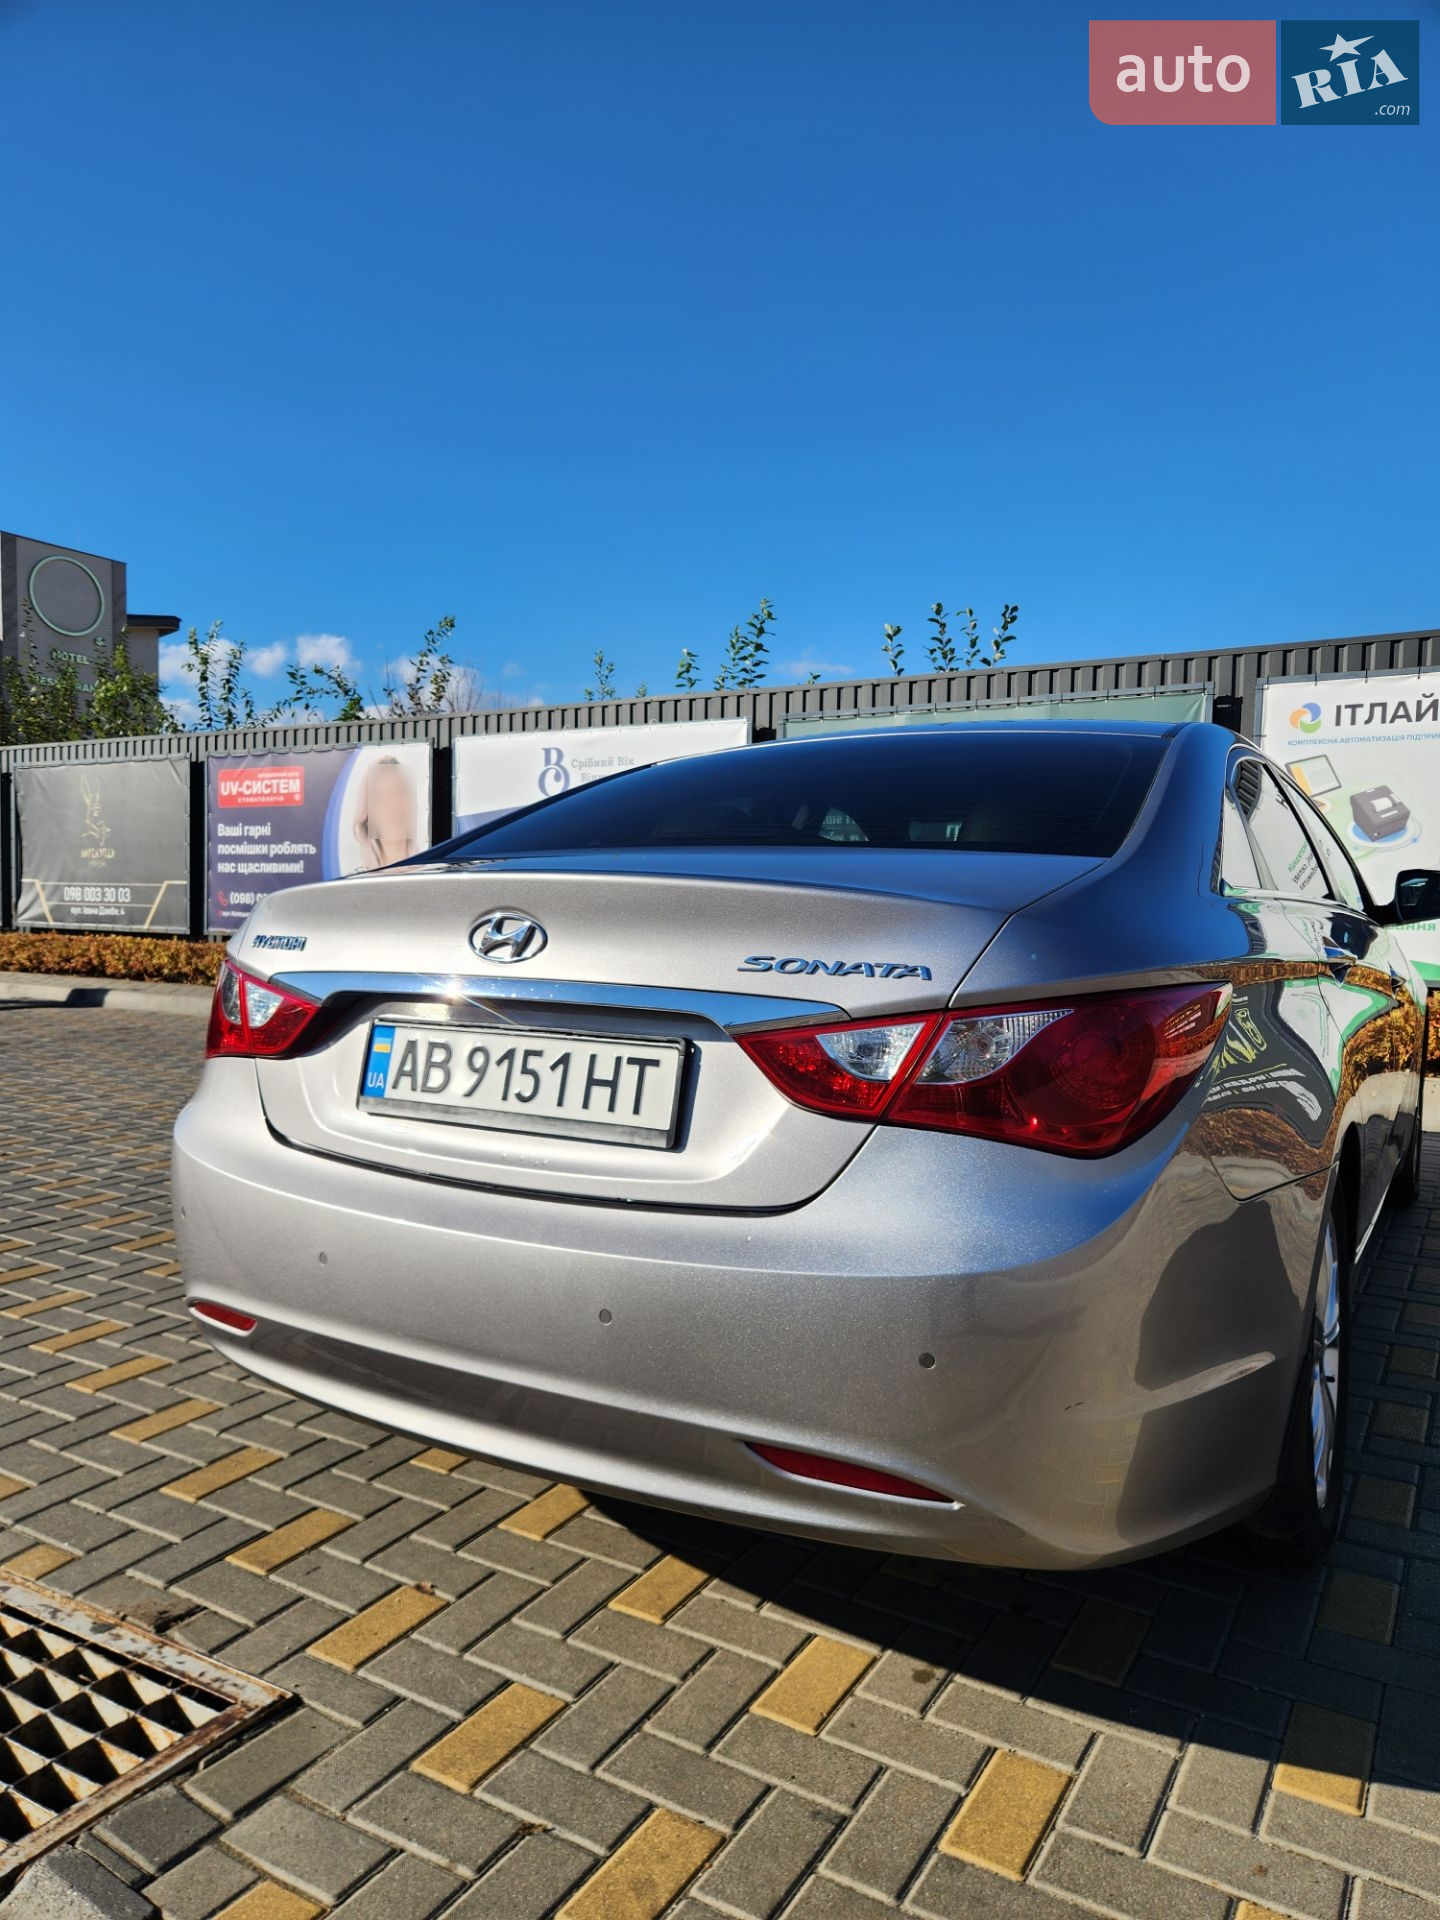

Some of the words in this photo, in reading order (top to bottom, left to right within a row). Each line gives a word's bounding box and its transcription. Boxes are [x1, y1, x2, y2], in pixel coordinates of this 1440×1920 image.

[51, 651, 90, 665] HOTEL
[1288, 738, 1338, 747] КОМПЛЕКСНА
[1339, 735, 1405, 745] АВТОМАТИЗАЦІЯ
[571, 757, 615, 770] Срібний
[617, 756, 636, 767] Вік
[221, 778, 301, 796] UV-СИСТЕМ
[217, 822, 243, 837] Ваші
[244, 822, 271, 839] гарні
[217, 841, 268, 855] посмішки
[269, 841, 317, 857] роблять
[217, 862, 236, 873] нас
[237, 860, 304, 875] щасливими!
[64, 886, 82, 901] 098
[84, 887, 102, 902] 003
[103, 887, 117, 902] 30
[118, 887, 131, 903] 03
[229, 891, 255, 905] (098)
[737, 955, 933, 981] SONATA
[367, 1071, 385, 1089] UA
[391, 1038, 453, 1094] AB
[463, 1045, 572, 1108] 9151
[581, 1053, 660, 1115] HT
